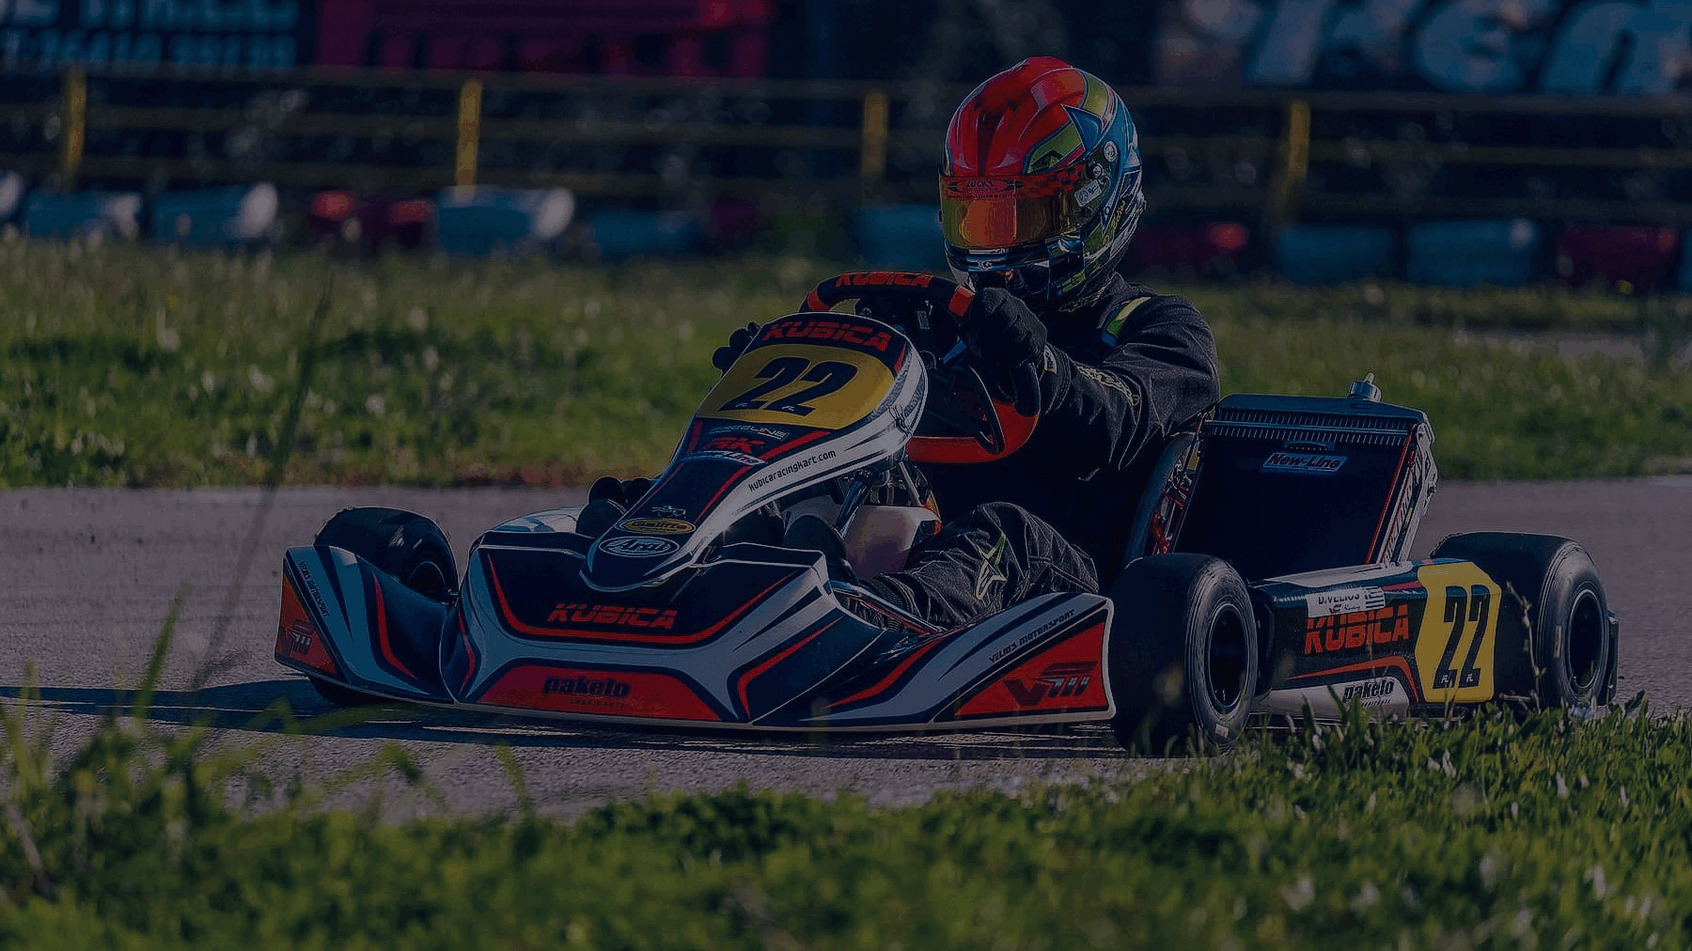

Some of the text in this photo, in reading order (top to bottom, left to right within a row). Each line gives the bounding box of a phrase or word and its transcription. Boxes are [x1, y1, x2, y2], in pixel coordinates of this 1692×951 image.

[835, 271, 933, 288] KUBICA
[762, 320, 892, 351] KUBICA
[717, 356, 858, 417] 22
[748, 450, 837, 492] kubicaracingkart.com
[1267, 453, 1340, 469] New-Line
[546, 602, 678, 630] KUBICA
[1304, 603, 1410, 655] KUBICA
[988, 608, 1076, 663] VELIOS MOTORSPORT
[1432, 584, 1491, 690] 22
[543, 676, 630, 698] pakelo
[1343, 679, 1395, 703] pakelo
